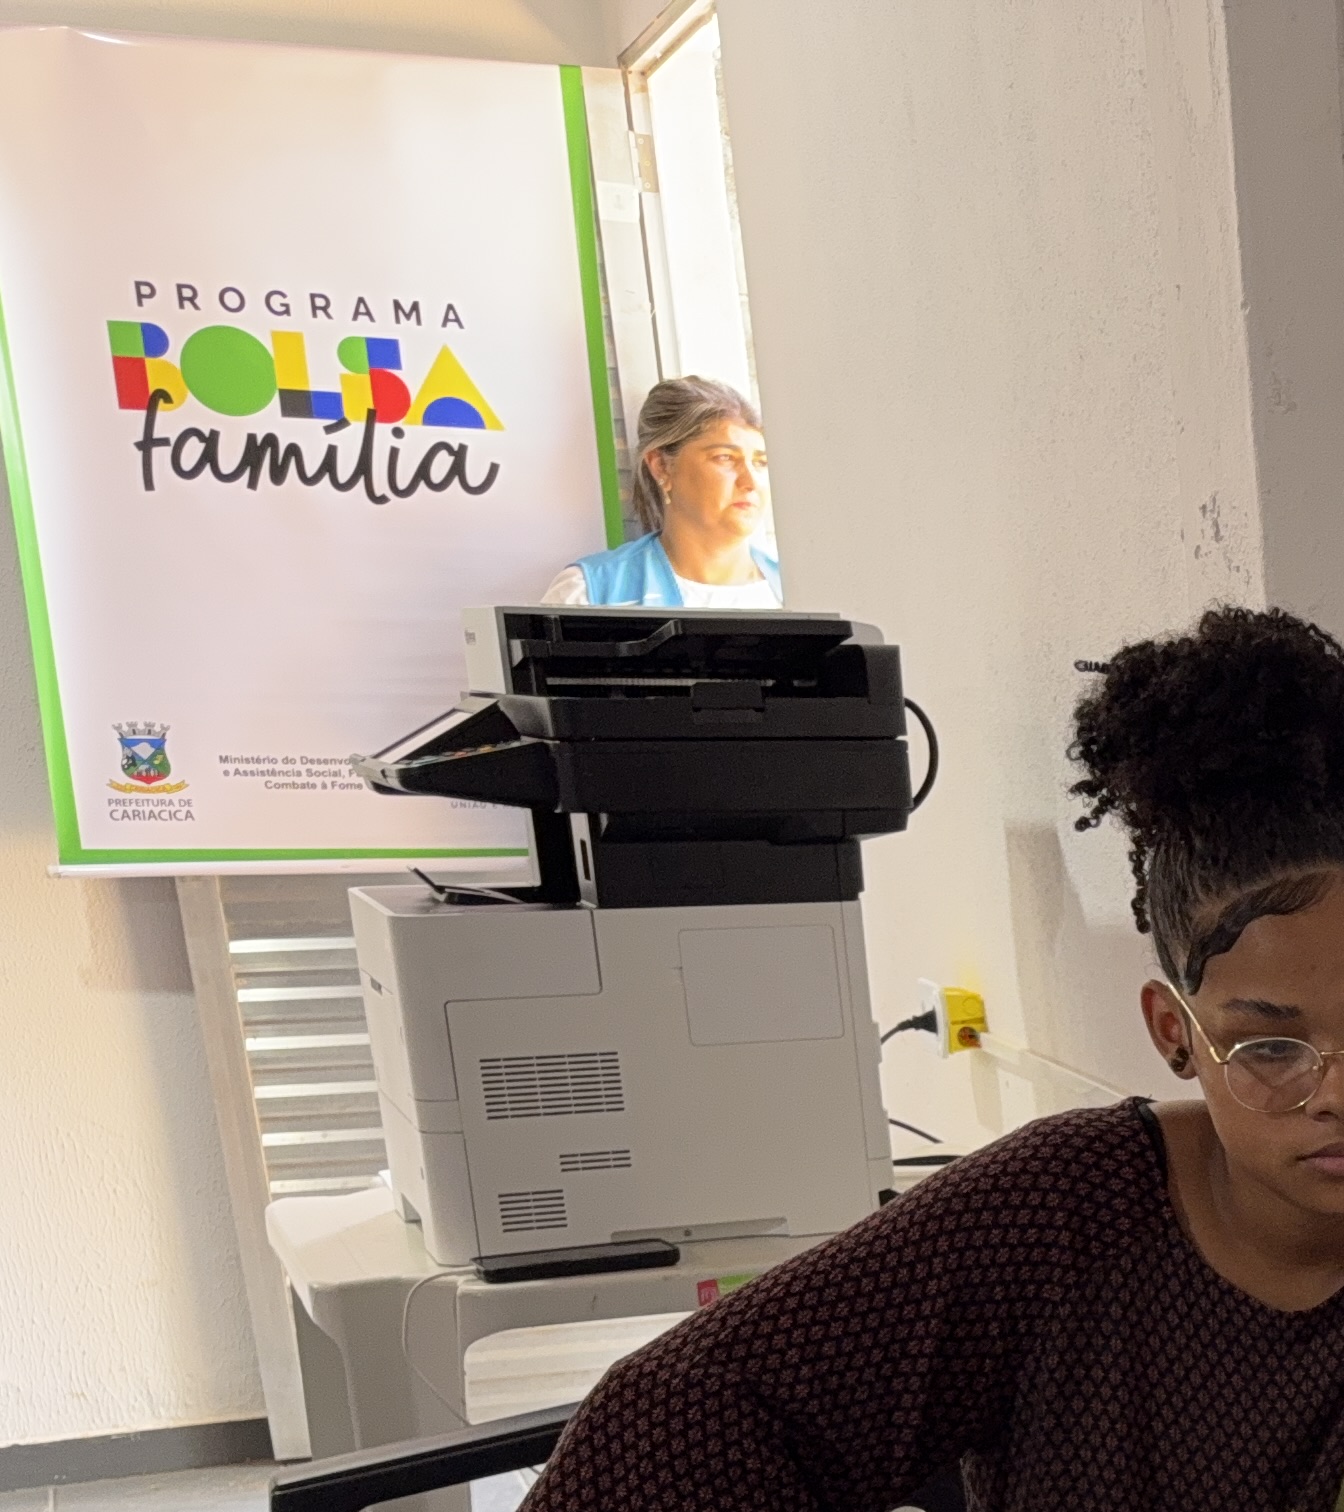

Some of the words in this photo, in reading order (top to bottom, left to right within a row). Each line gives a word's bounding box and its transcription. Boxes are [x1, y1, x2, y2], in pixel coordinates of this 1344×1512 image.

[134, 280, 465, 329] PROGRAMA
[107, 320, 505, 430] BOLSA
[134, 388, 500, 505] família
[218, 755, 278, 765] Ministério
[281, 755, 297, 766] do
[233, 767, 302, 777] Assistência
[264, 780, 317, 790] Combate
[331, 781, 363, 790] Fome
[107, 798, 175, 808] PREFEITURA
[178, 799, 193, 808] DE
[109, 809, 195, 821] CARIACICA
